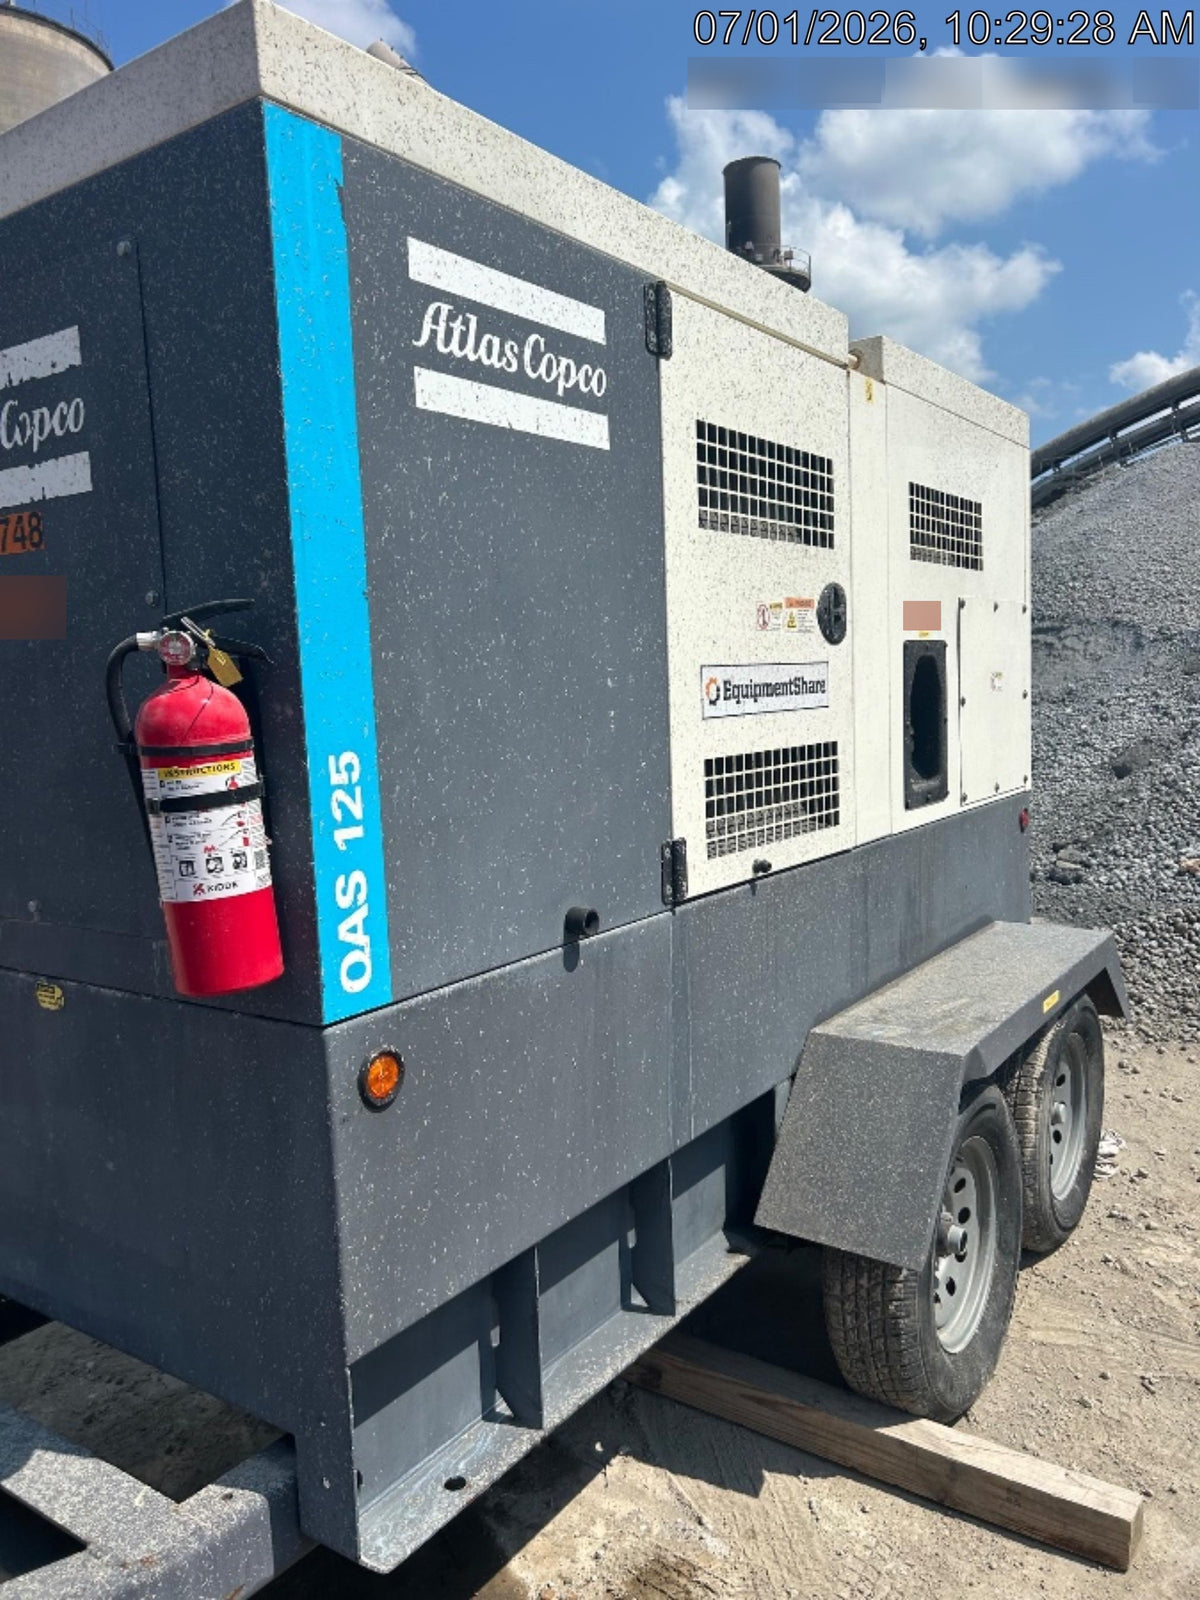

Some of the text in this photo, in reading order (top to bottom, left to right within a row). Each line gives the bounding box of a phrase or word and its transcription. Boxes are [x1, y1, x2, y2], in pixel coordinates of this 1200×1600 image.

[412, 301, 608, 397] Atlas Copco
[0, 397, 85, 453] Copco
[722, 676, 827, 705] EquipmentShare
[328, 750, 364, 851] 125
